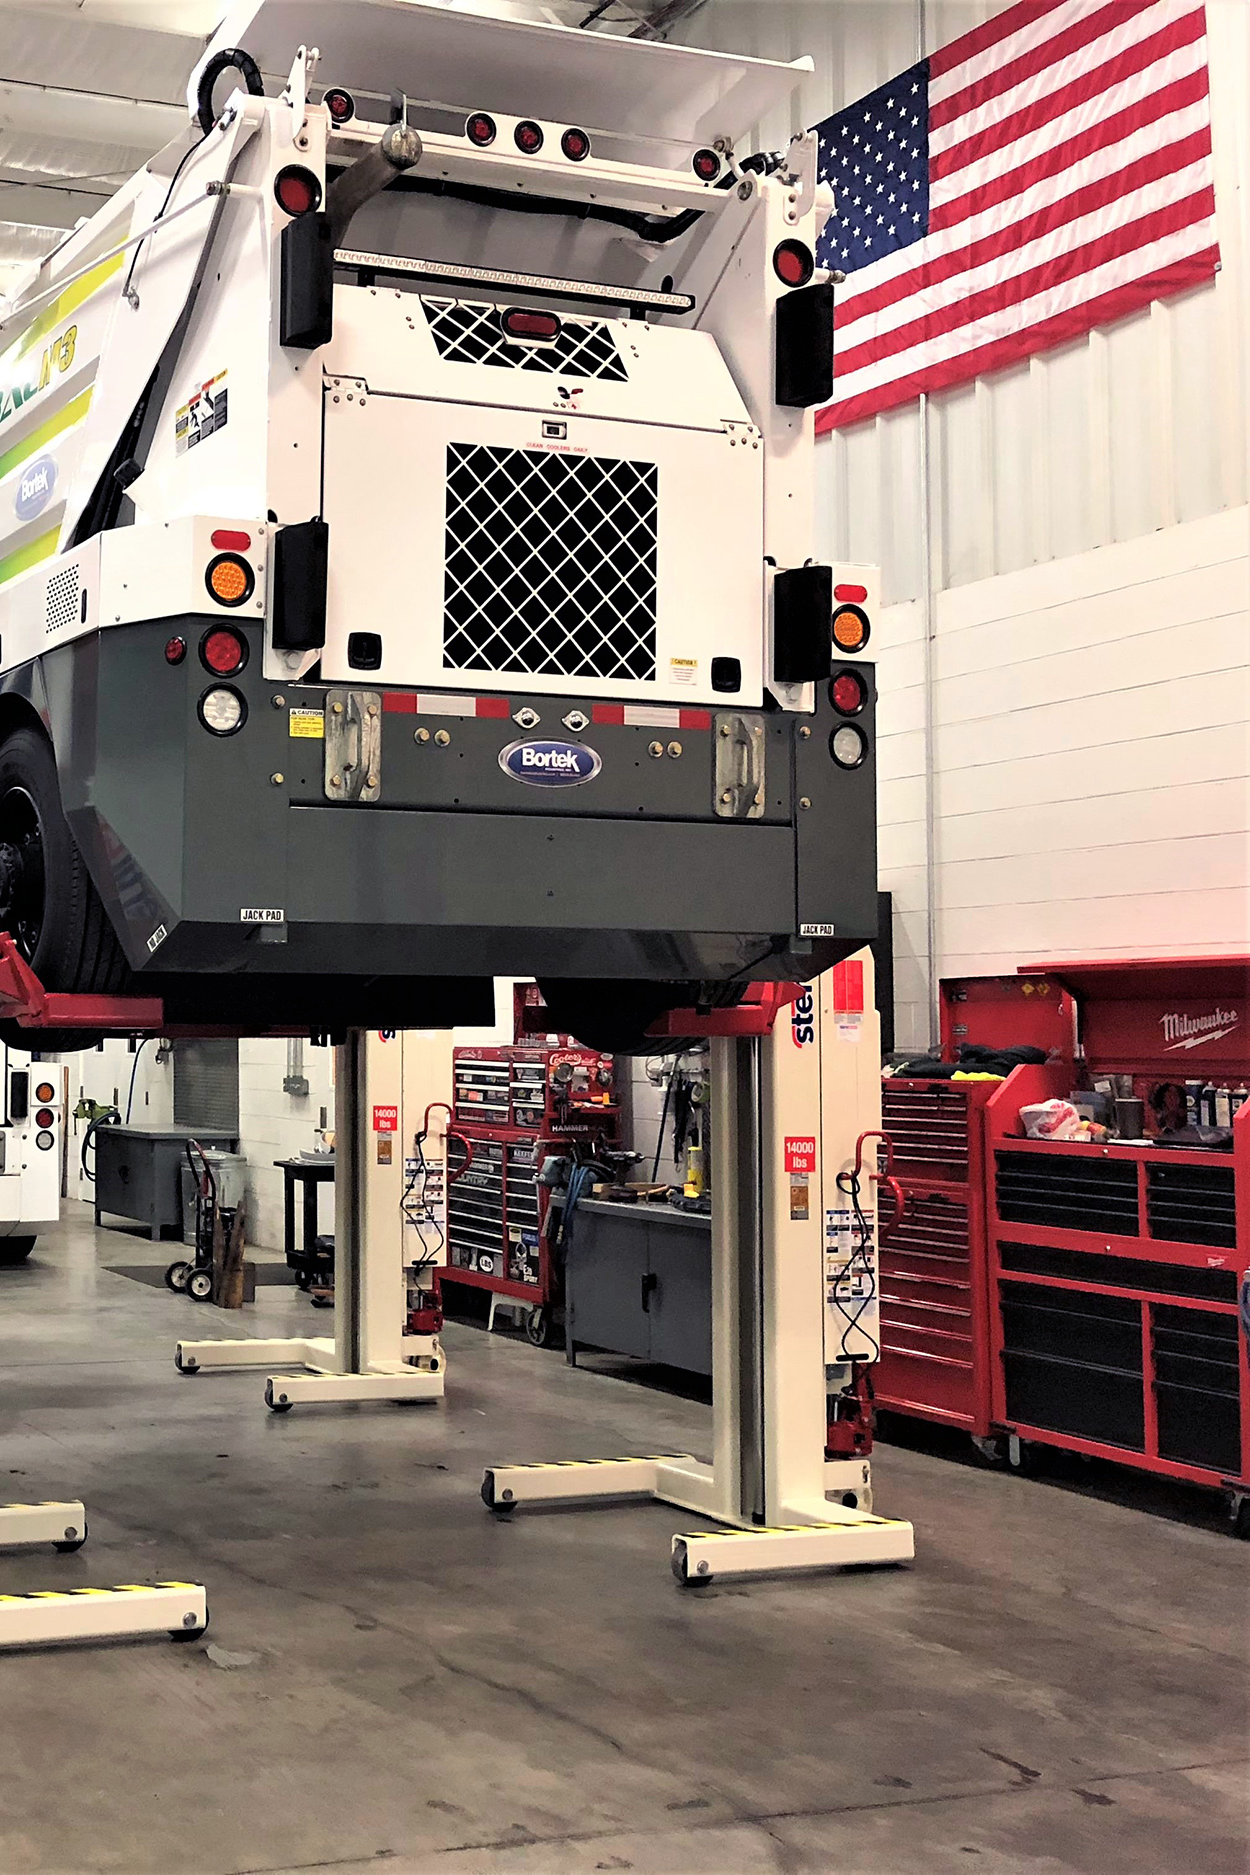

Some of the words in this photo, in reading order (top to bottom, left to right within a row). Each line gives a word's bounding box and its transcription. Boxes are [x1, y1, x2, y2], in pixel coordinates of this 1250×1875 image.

[546, 443, 571, 452] COOLERS
[21, 466, 49, 502] Bortek
[521, 747, 580, 772] Bortek
[243, 910, 264, 920] JACK
[266, 911, 282, 920] PAD
[802, 925, 819, 935] JACK
[819, 925, 832, 935] PAD
[1158, 1007, 1239, 1042] Milwaukee
[374, 1109, 396, 1118] 14000
[379, 1120, 391, 1128] lbs
[551, 1124, 589, 1133] HAMMER
[786, 1141, 814, 1154] 14000
[792, 1156, 807, 1168] lbs
